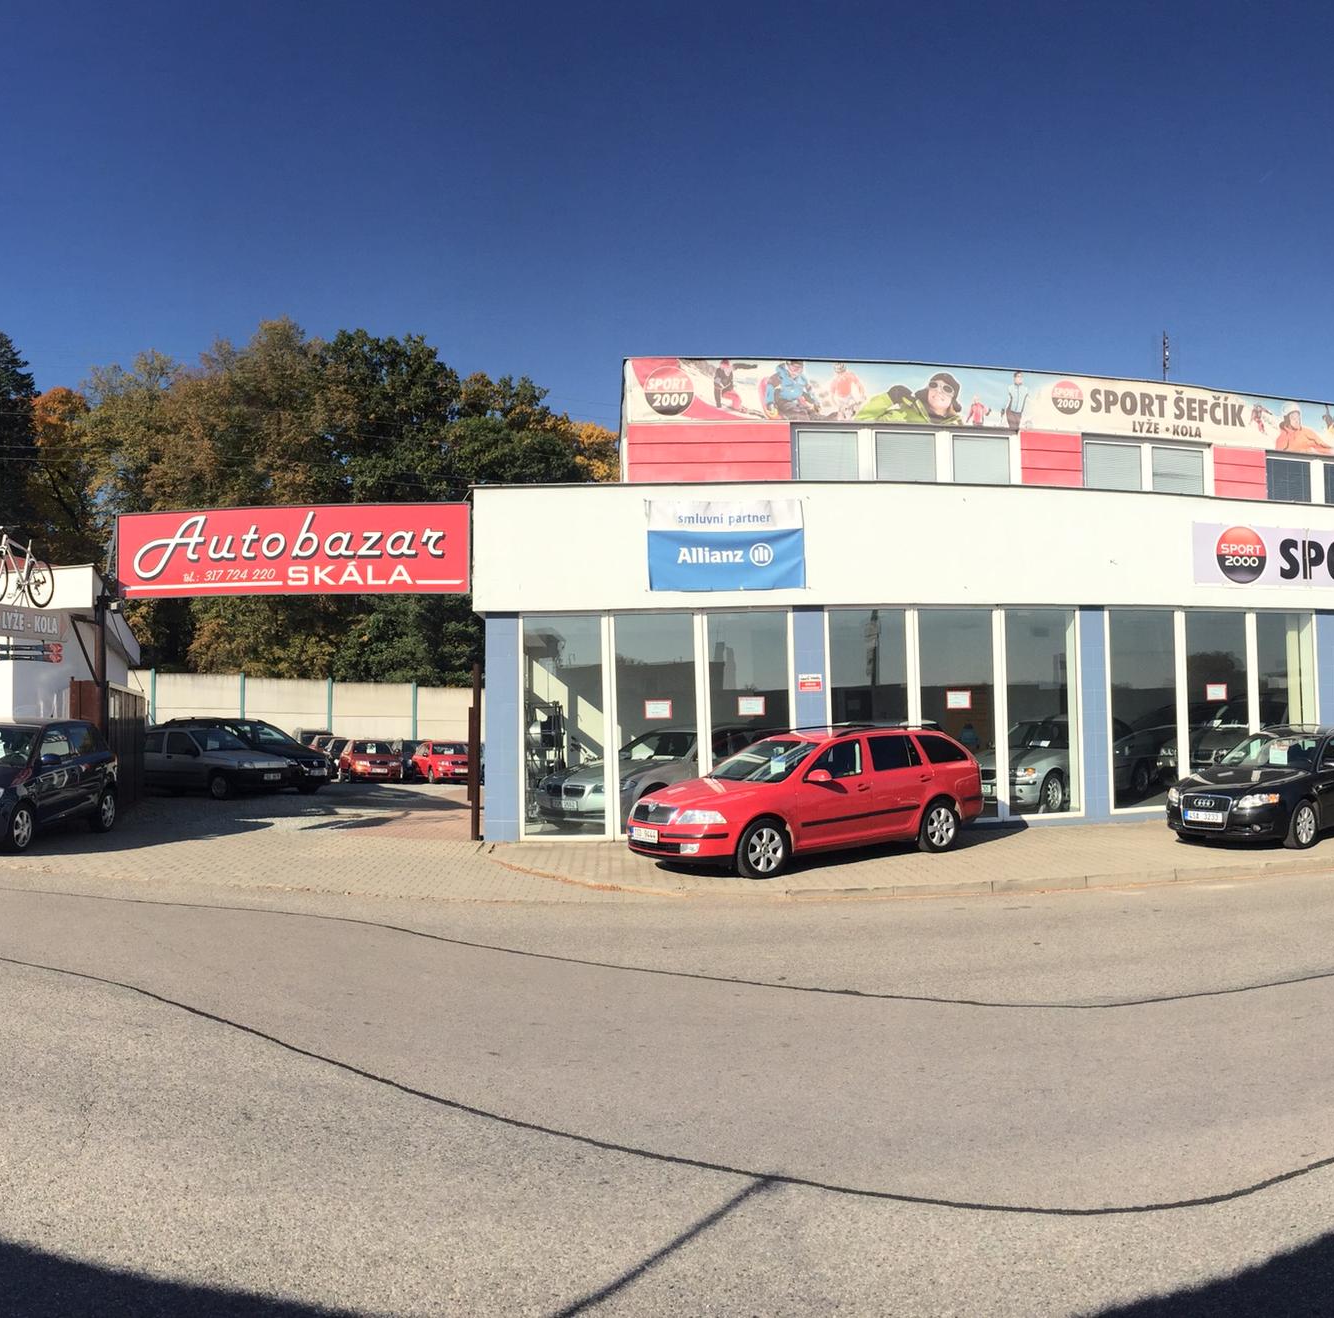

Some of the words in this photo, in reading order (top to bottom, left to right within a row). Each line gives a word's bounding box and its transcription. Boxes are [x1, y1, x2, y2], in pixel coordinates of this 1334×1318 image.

[647, 377, 688, 390] SPORT
[652, 393, 689, 406] 2000
[1052, 387, 1079, 398] SPORT
[1056, 398, 1081, 409] 2000
[1090, 388, 1167, 418] SPORT
[1173, 389, 1246, 428] ŠEFČÍK
[1132, 418, 1160, 435] LYŽE
[1172, 424, 1202, 439] KOLA
[678, 512, 724, 525] smluvní
[728, 513, 771, 526] partner
[133, 510, 446, 580] Autobazar
[1221, 543, 1262, 556] SPORT
[677, 546, 745, 564] Allianz
[1224, 556, 1260, 568] 2000
[203, 568, 223, 582] 317
[225, 568, 249, 581] 724
[252, 568, 276, 580] 220
[286, 561, 414, 586] SKÁLA
[1, 609, 25, 632] LYŽE
[33, 614, 58, 634] KOLA
